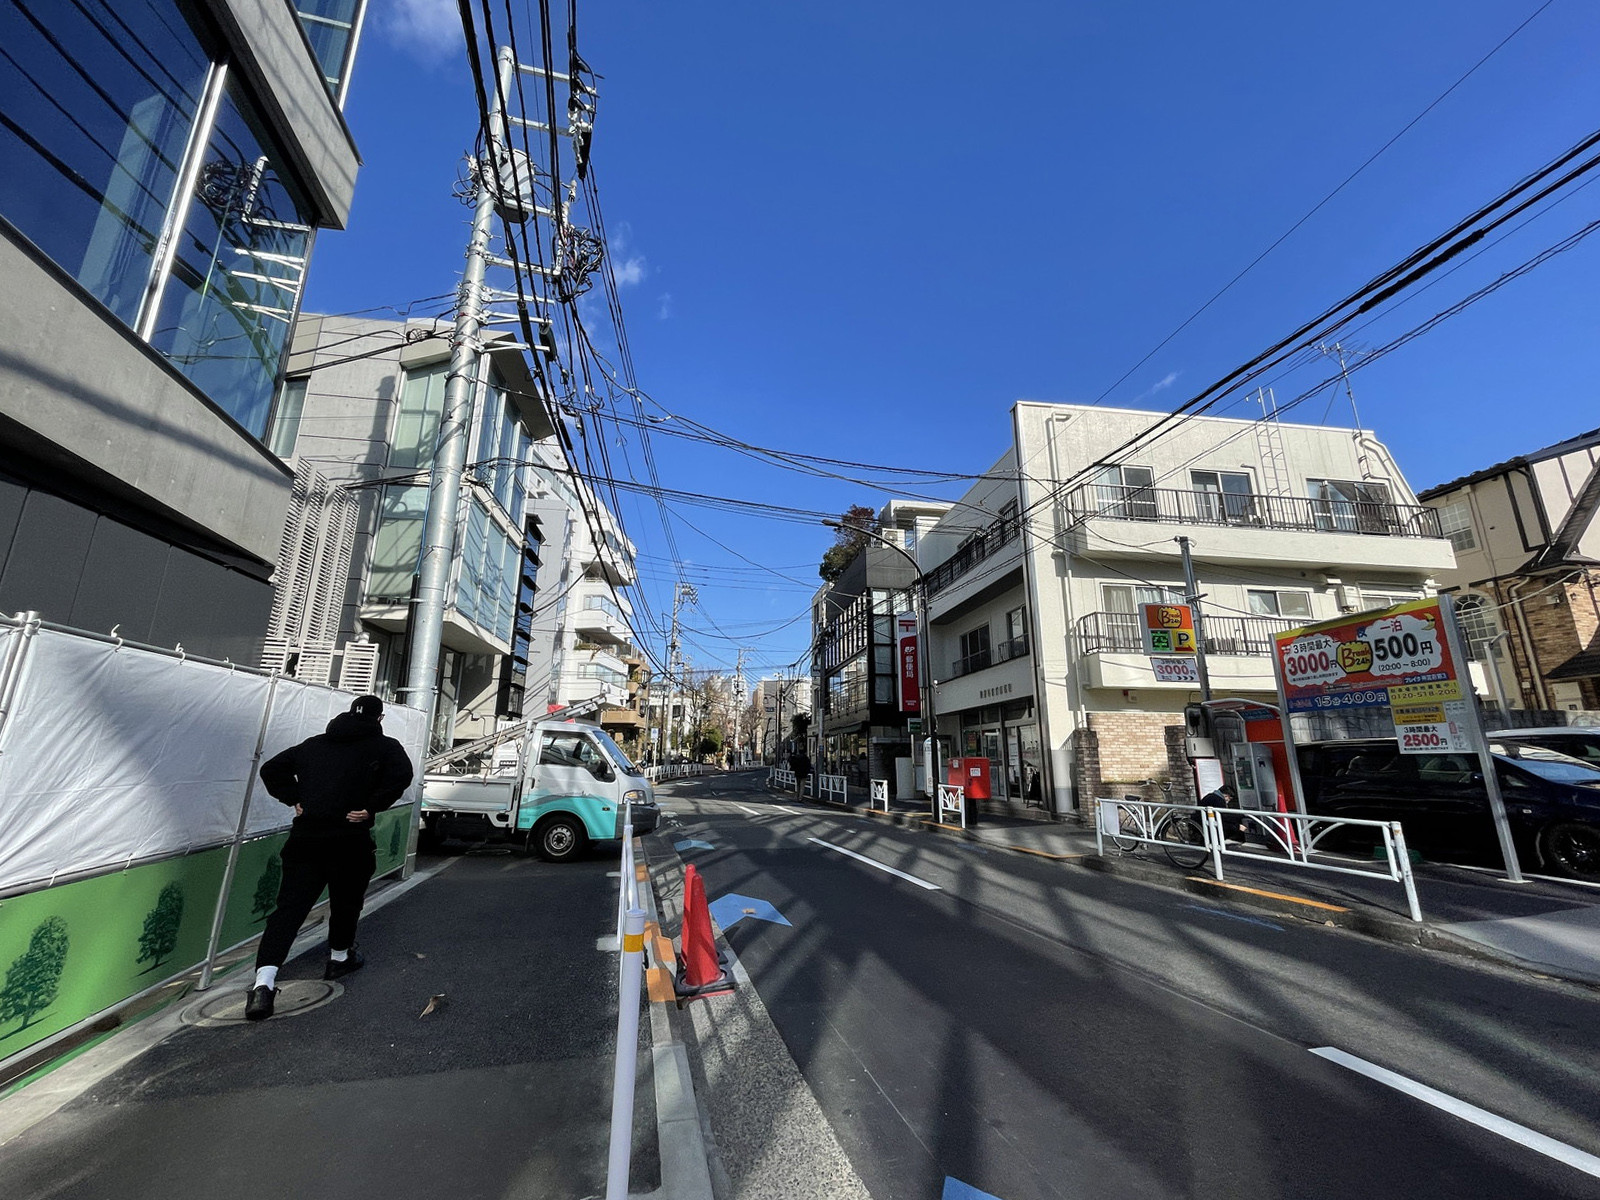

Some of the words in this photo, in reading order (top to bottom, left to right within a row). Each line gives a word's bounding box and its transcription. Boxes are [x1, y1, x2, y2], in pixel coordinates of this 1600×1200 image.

[1380, 620, 1402, 632] 一泊
[1178, 633, 1189, 645] P
[1293, 638, 1332, 654] 3時間最大
[1374, 632, 1433, 661] 500円
[1287, 651, 1338, 676] 3000円
[1404, 725, 1438, 733] 3時間最大
[1403, 733, 1448, 747] 2500円
